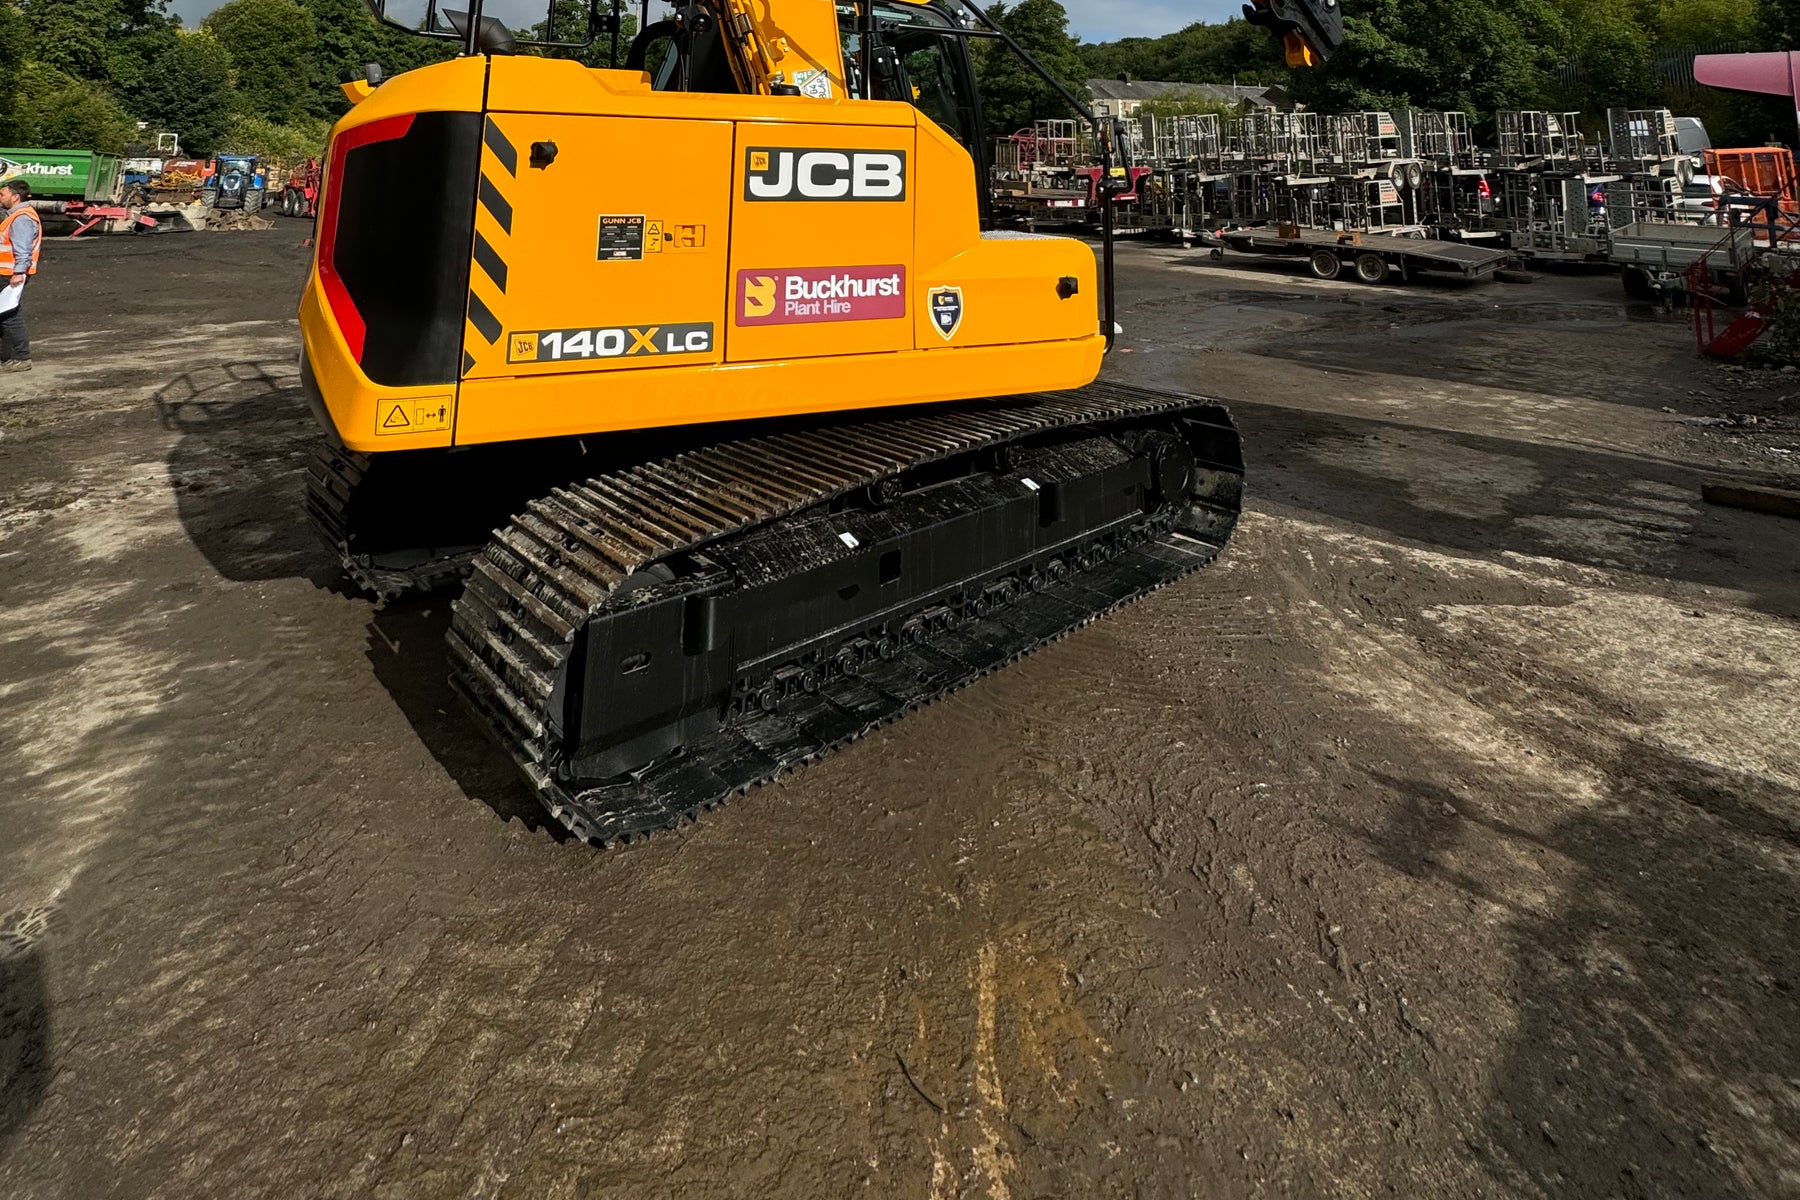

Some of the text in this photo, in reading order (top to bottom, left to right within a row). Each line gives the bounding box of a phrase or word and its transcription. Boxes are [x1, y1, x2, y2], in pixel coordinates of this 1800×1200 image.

[749, 152, 903, 198] JCB
[602, 217, 642, 225] GUNN JCB
[785, 273, 900, 300] Buckhurst
[784, 299, 852, 316] Plant Hire
[666, 331, 709, 352] LC
